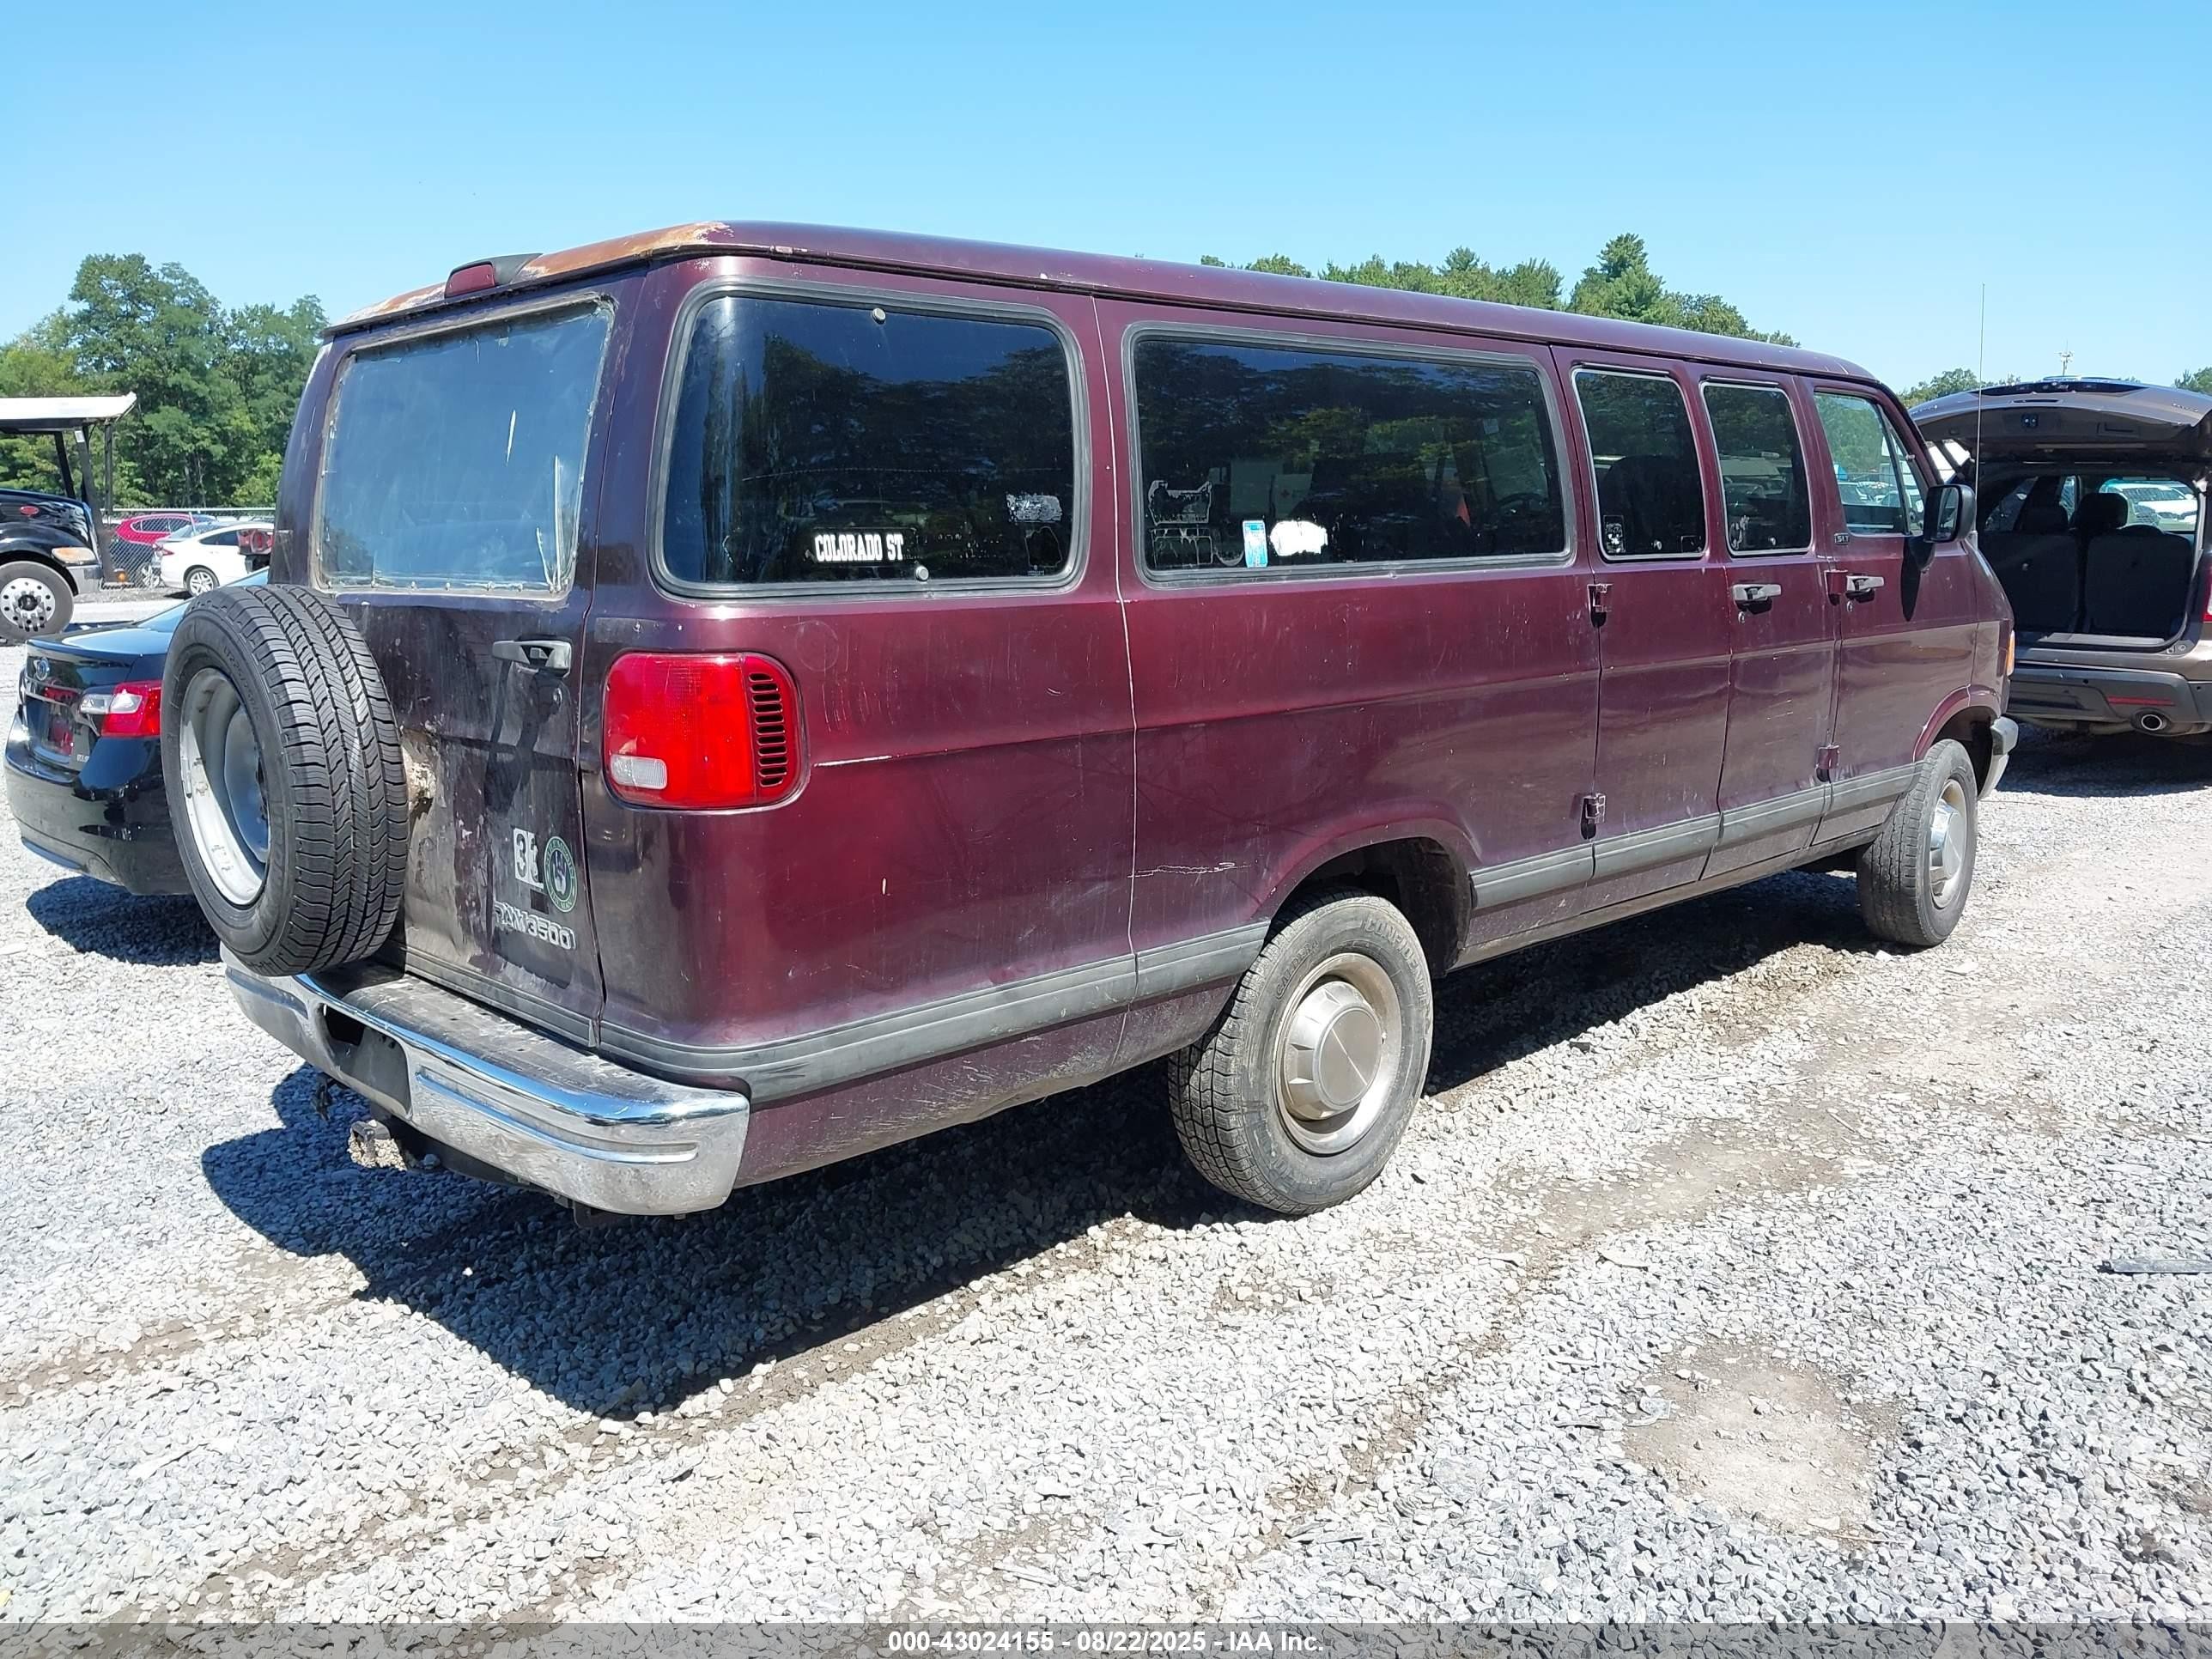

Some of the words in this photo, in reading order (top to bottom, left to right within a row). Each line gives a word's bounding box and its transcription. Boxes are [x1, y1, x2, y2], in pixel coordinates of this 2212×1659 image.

[814, 534, 883, 562] COLORADO
[886, 533, 904, 561] ST
[1364, 918, 1428, 1006] CONFIDENCE
